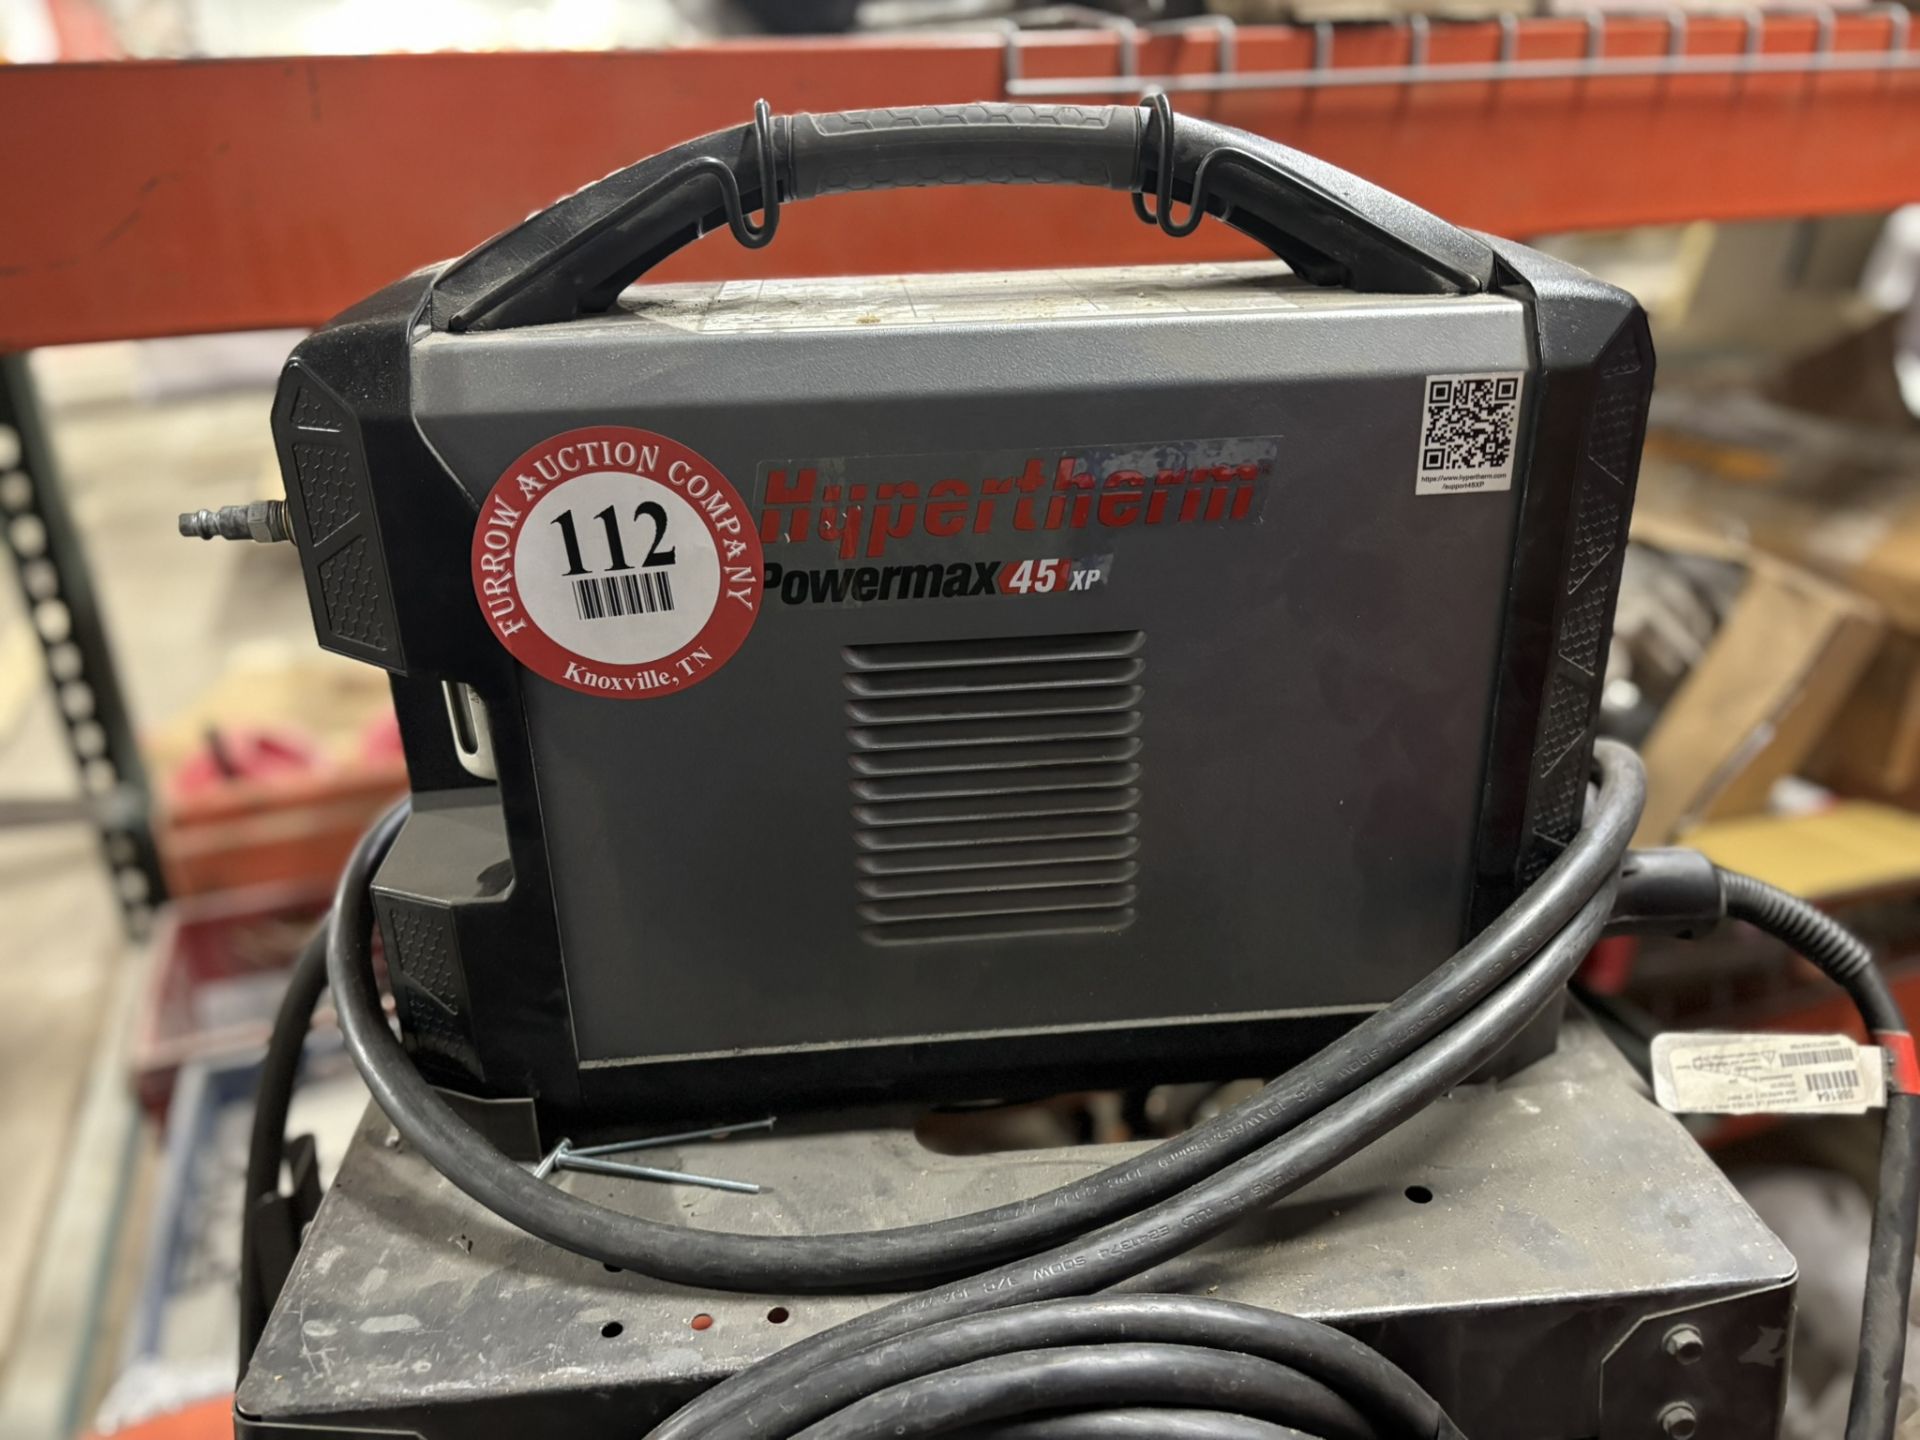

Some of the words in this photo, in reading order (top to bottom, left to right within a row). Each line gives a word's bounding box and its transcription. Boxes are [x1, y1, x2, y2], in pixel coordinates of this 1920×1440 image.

[481, 494, 528, 637] FURROW
[515, 441, 660, 501] AUCTION
[668, 460, 757, 611] COMPANY
[550, 501, 676, 577] 112
[761, 458, 1259, 559] Hypertherm
[763, 562, 1001, 604] Powermax
[1009, 558, 1060, 594] 45
[1069, 569, 1101, 591] XP
[562, 661, 680, 691] Knoxville,
[675, 646, 713, 677] TN
